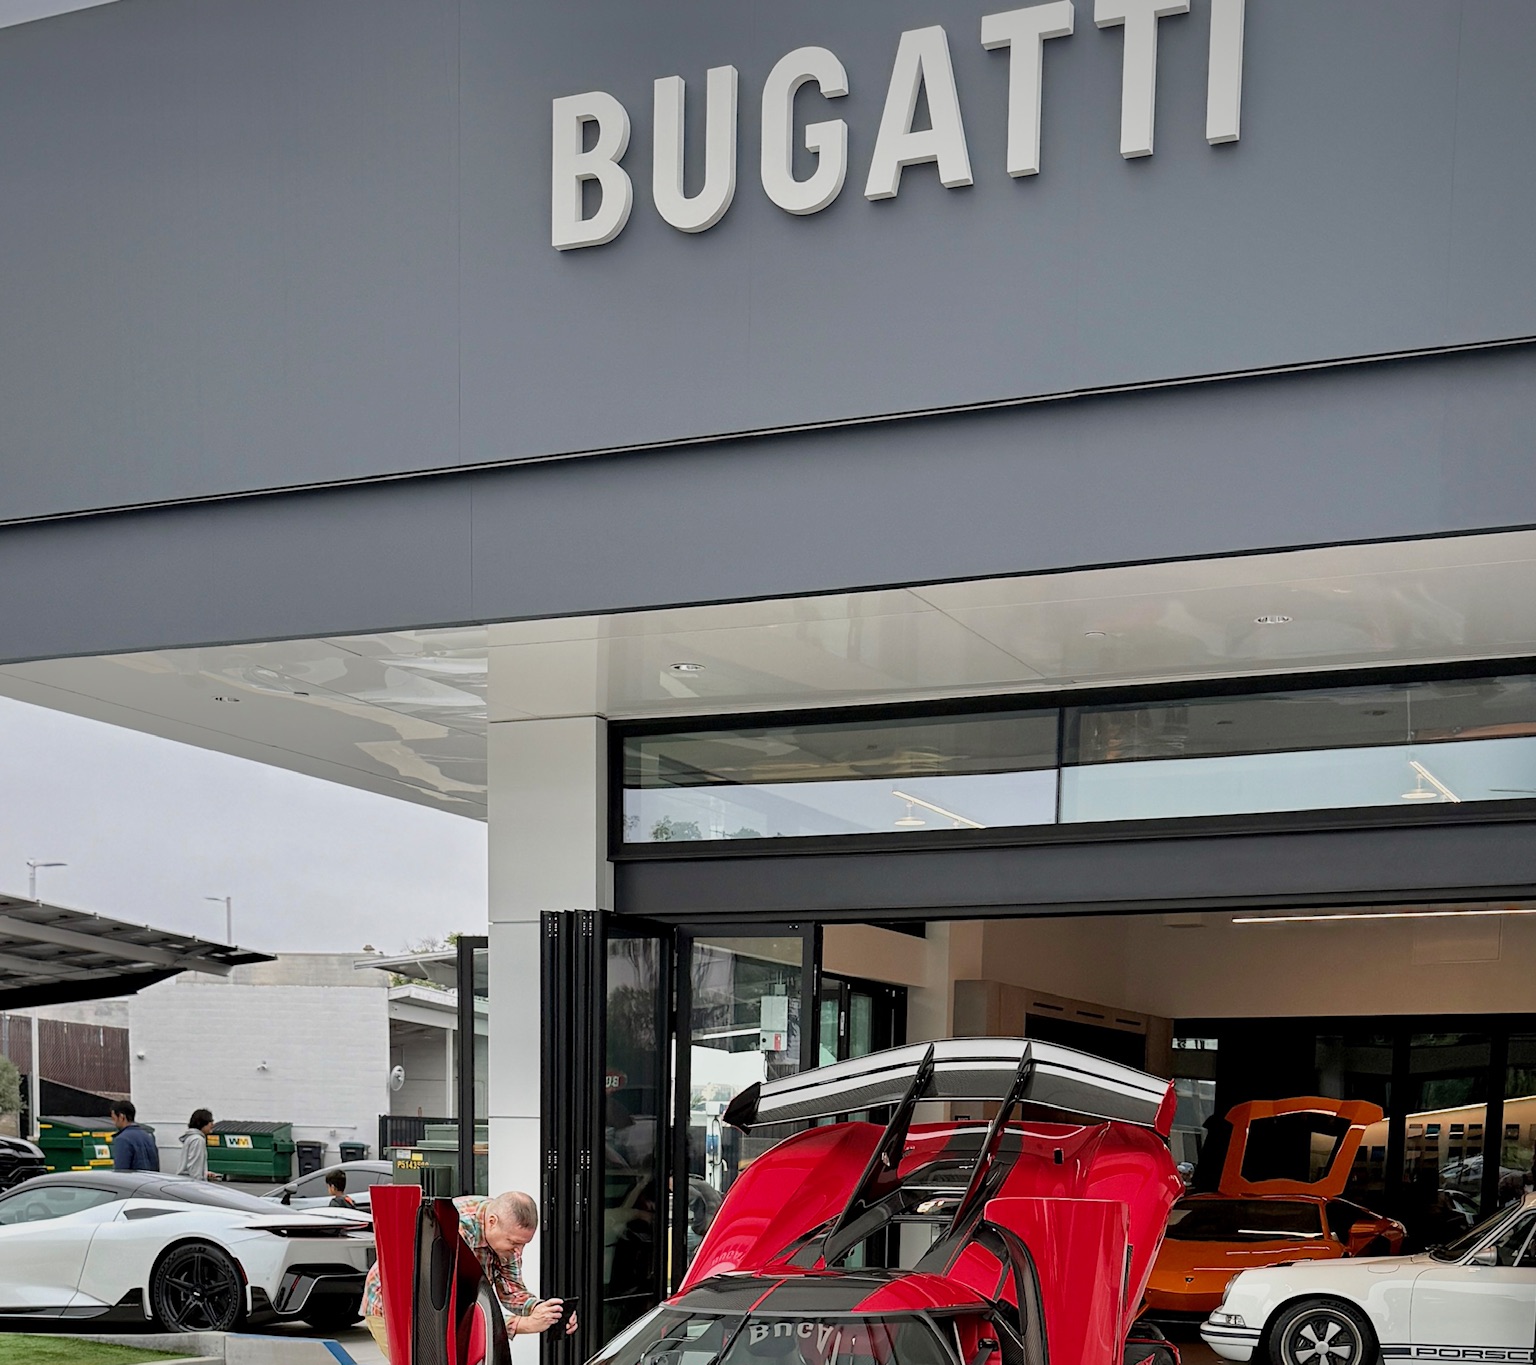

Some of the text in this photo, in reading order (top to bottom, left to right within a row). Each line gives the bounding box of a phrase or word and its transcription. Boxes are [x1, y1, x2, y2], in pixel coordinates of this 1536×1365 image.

[551, 0, 1246, 251] BUGATTI
[228, 1137, 250, 1146] WM
[1416, 1347, 1533, 1361] PORSC
